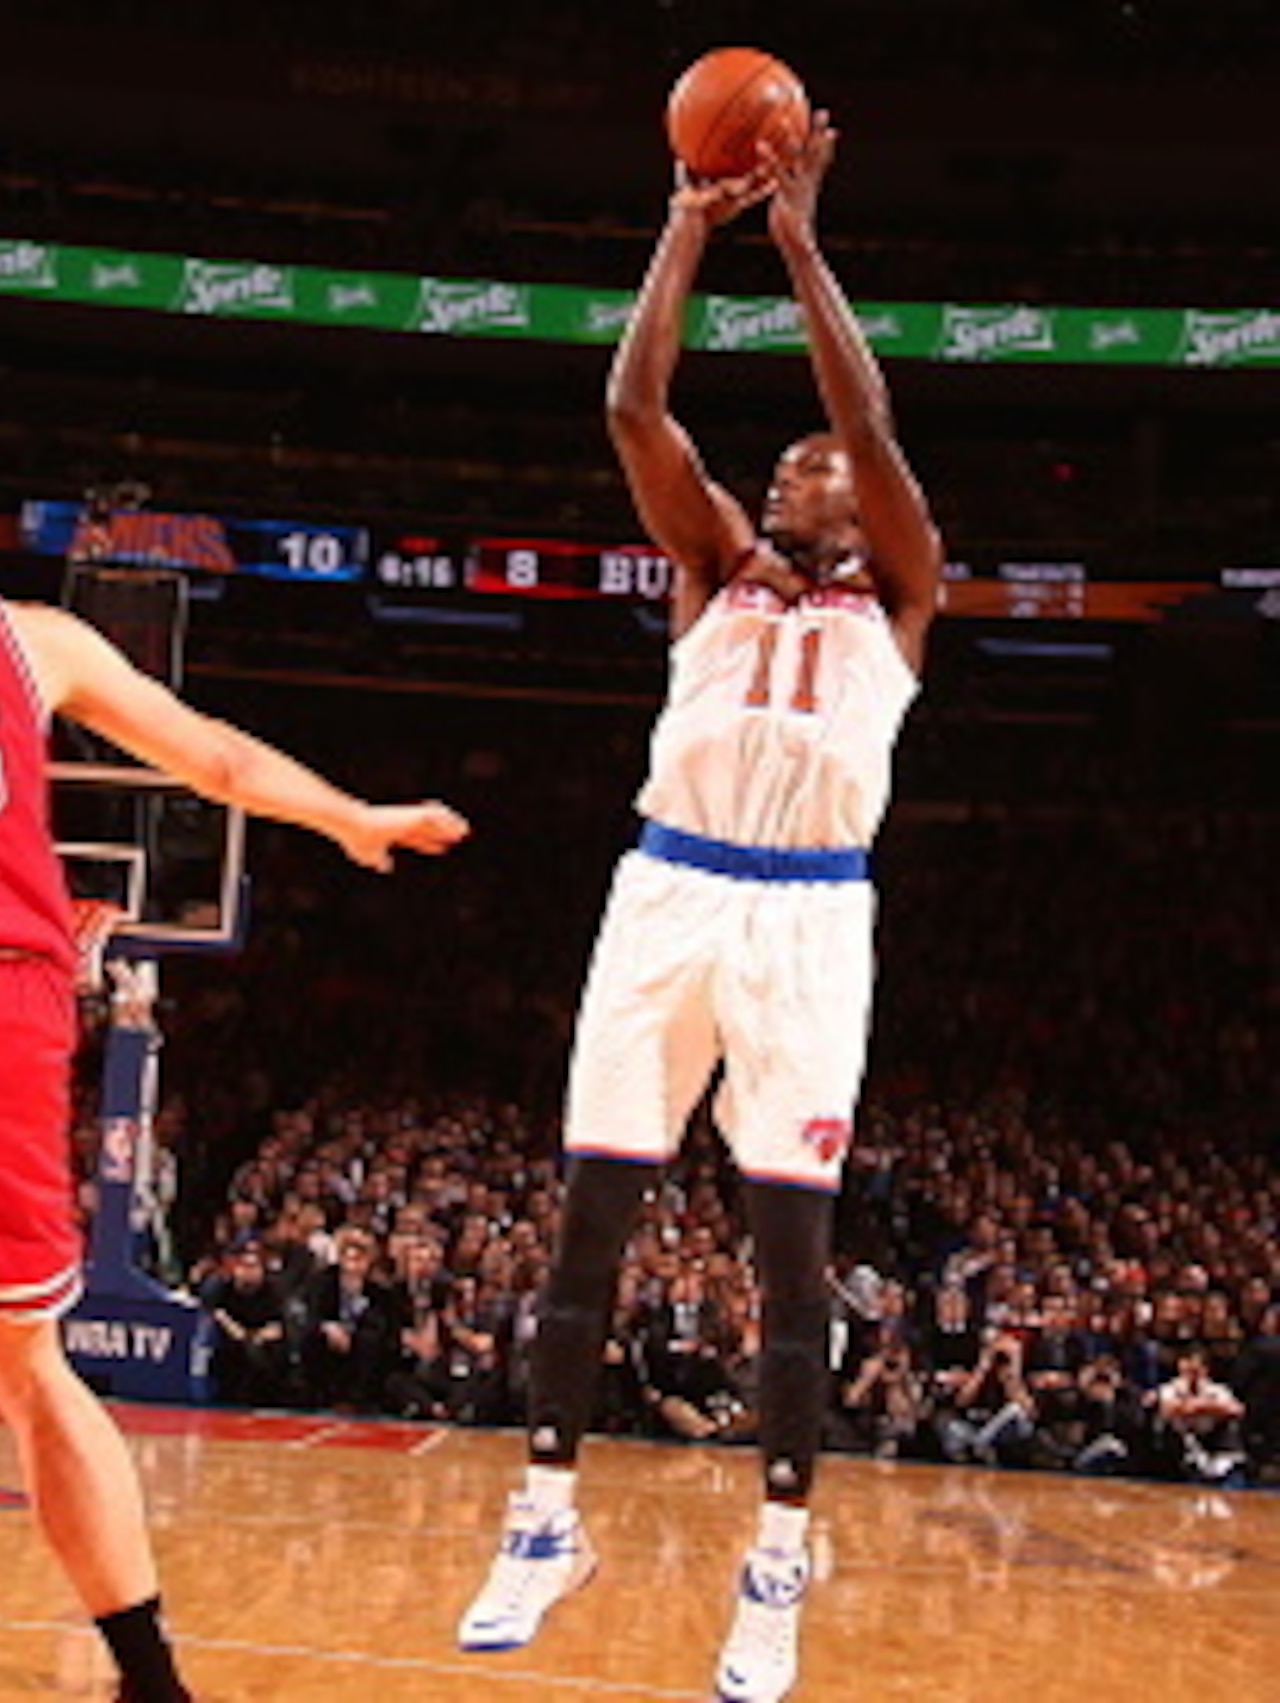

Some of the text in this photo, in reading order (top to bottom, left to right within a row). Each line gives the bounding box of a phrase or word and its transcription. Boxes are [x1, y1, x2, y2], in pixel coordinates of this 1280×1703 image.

[190, 264, 283, 315] Sprite
[426, 281, 518, 333] Sprite
[952, 304, 1042, 358] Sprite
[277, 532, 343, 574] 10
[506, 550, 538, 588] 8
[599, 551, 674, 600] BU
[743, 621, 824, 715] 11
[131, 1327, 170, 1362] TV
